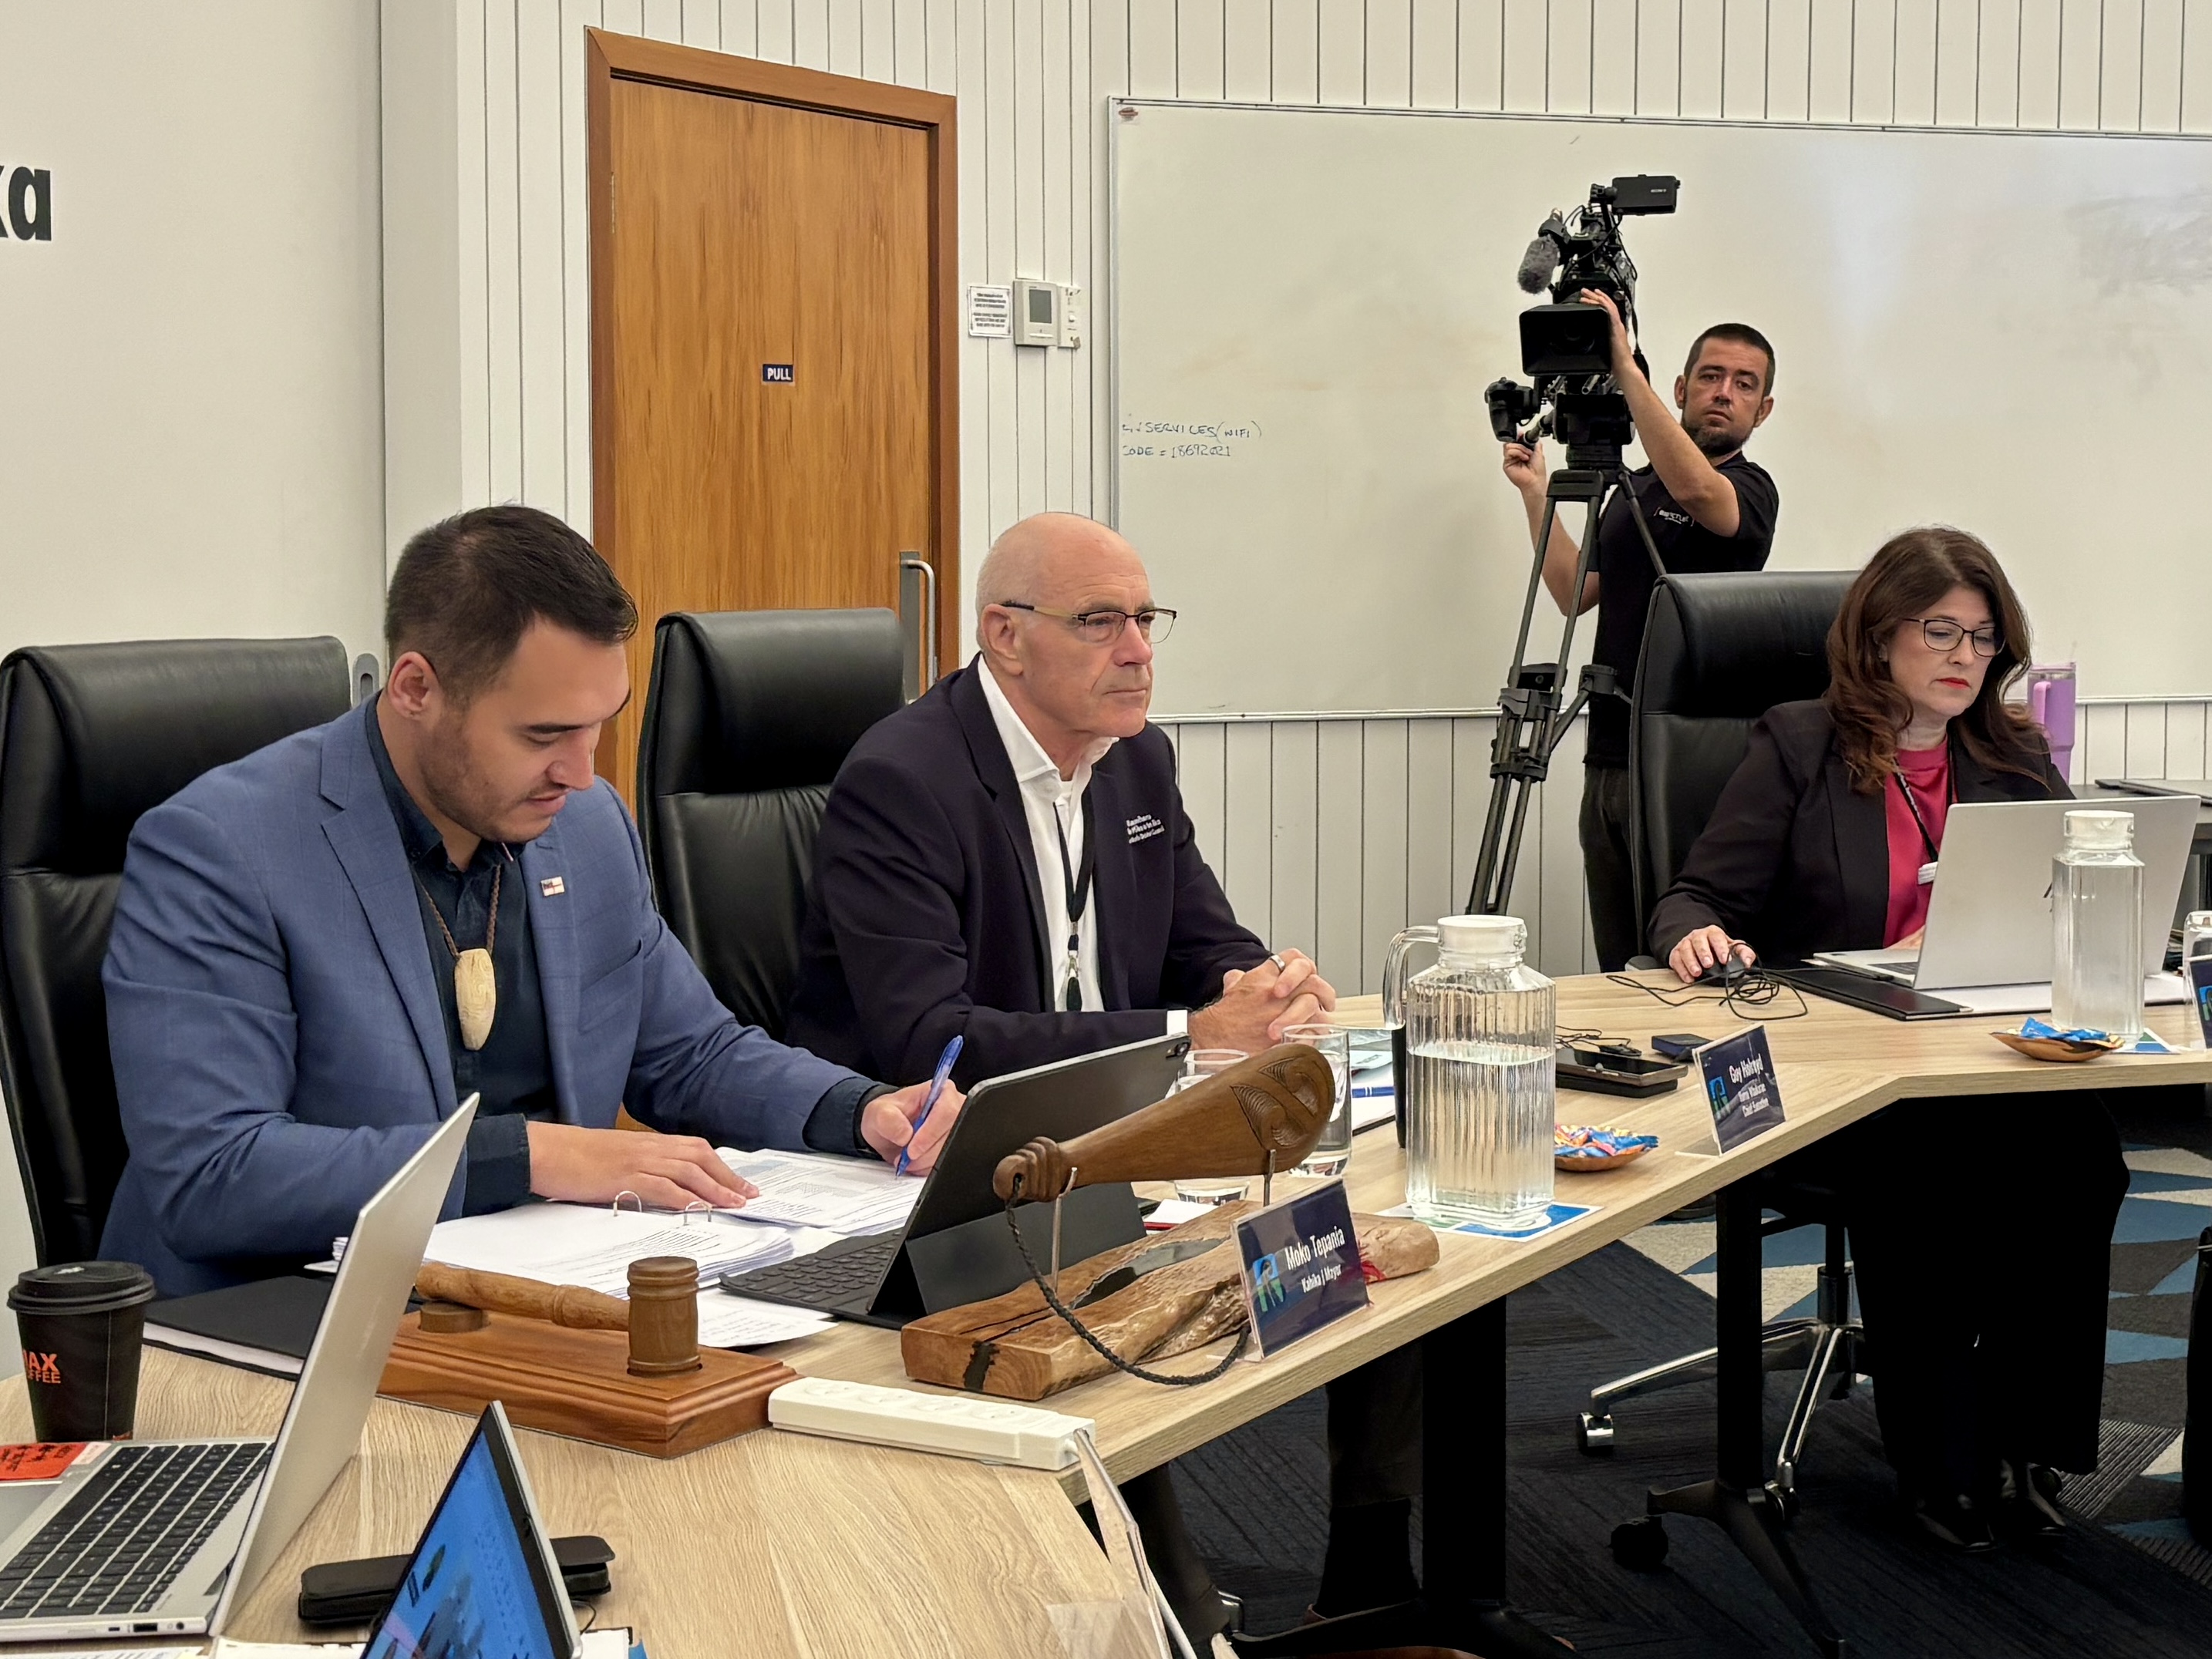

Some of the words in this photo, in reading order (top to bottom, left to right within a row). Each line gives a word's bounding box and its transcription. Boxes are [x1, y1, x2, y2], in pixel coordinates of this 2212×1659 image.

[767, 367, 791, 380] PULL
[1284, 1242, 1311, 1270] Moko
[1310, 1226, 1345, 1258] Tepania
[1324, 1264, 1342, 1281] Mayor
